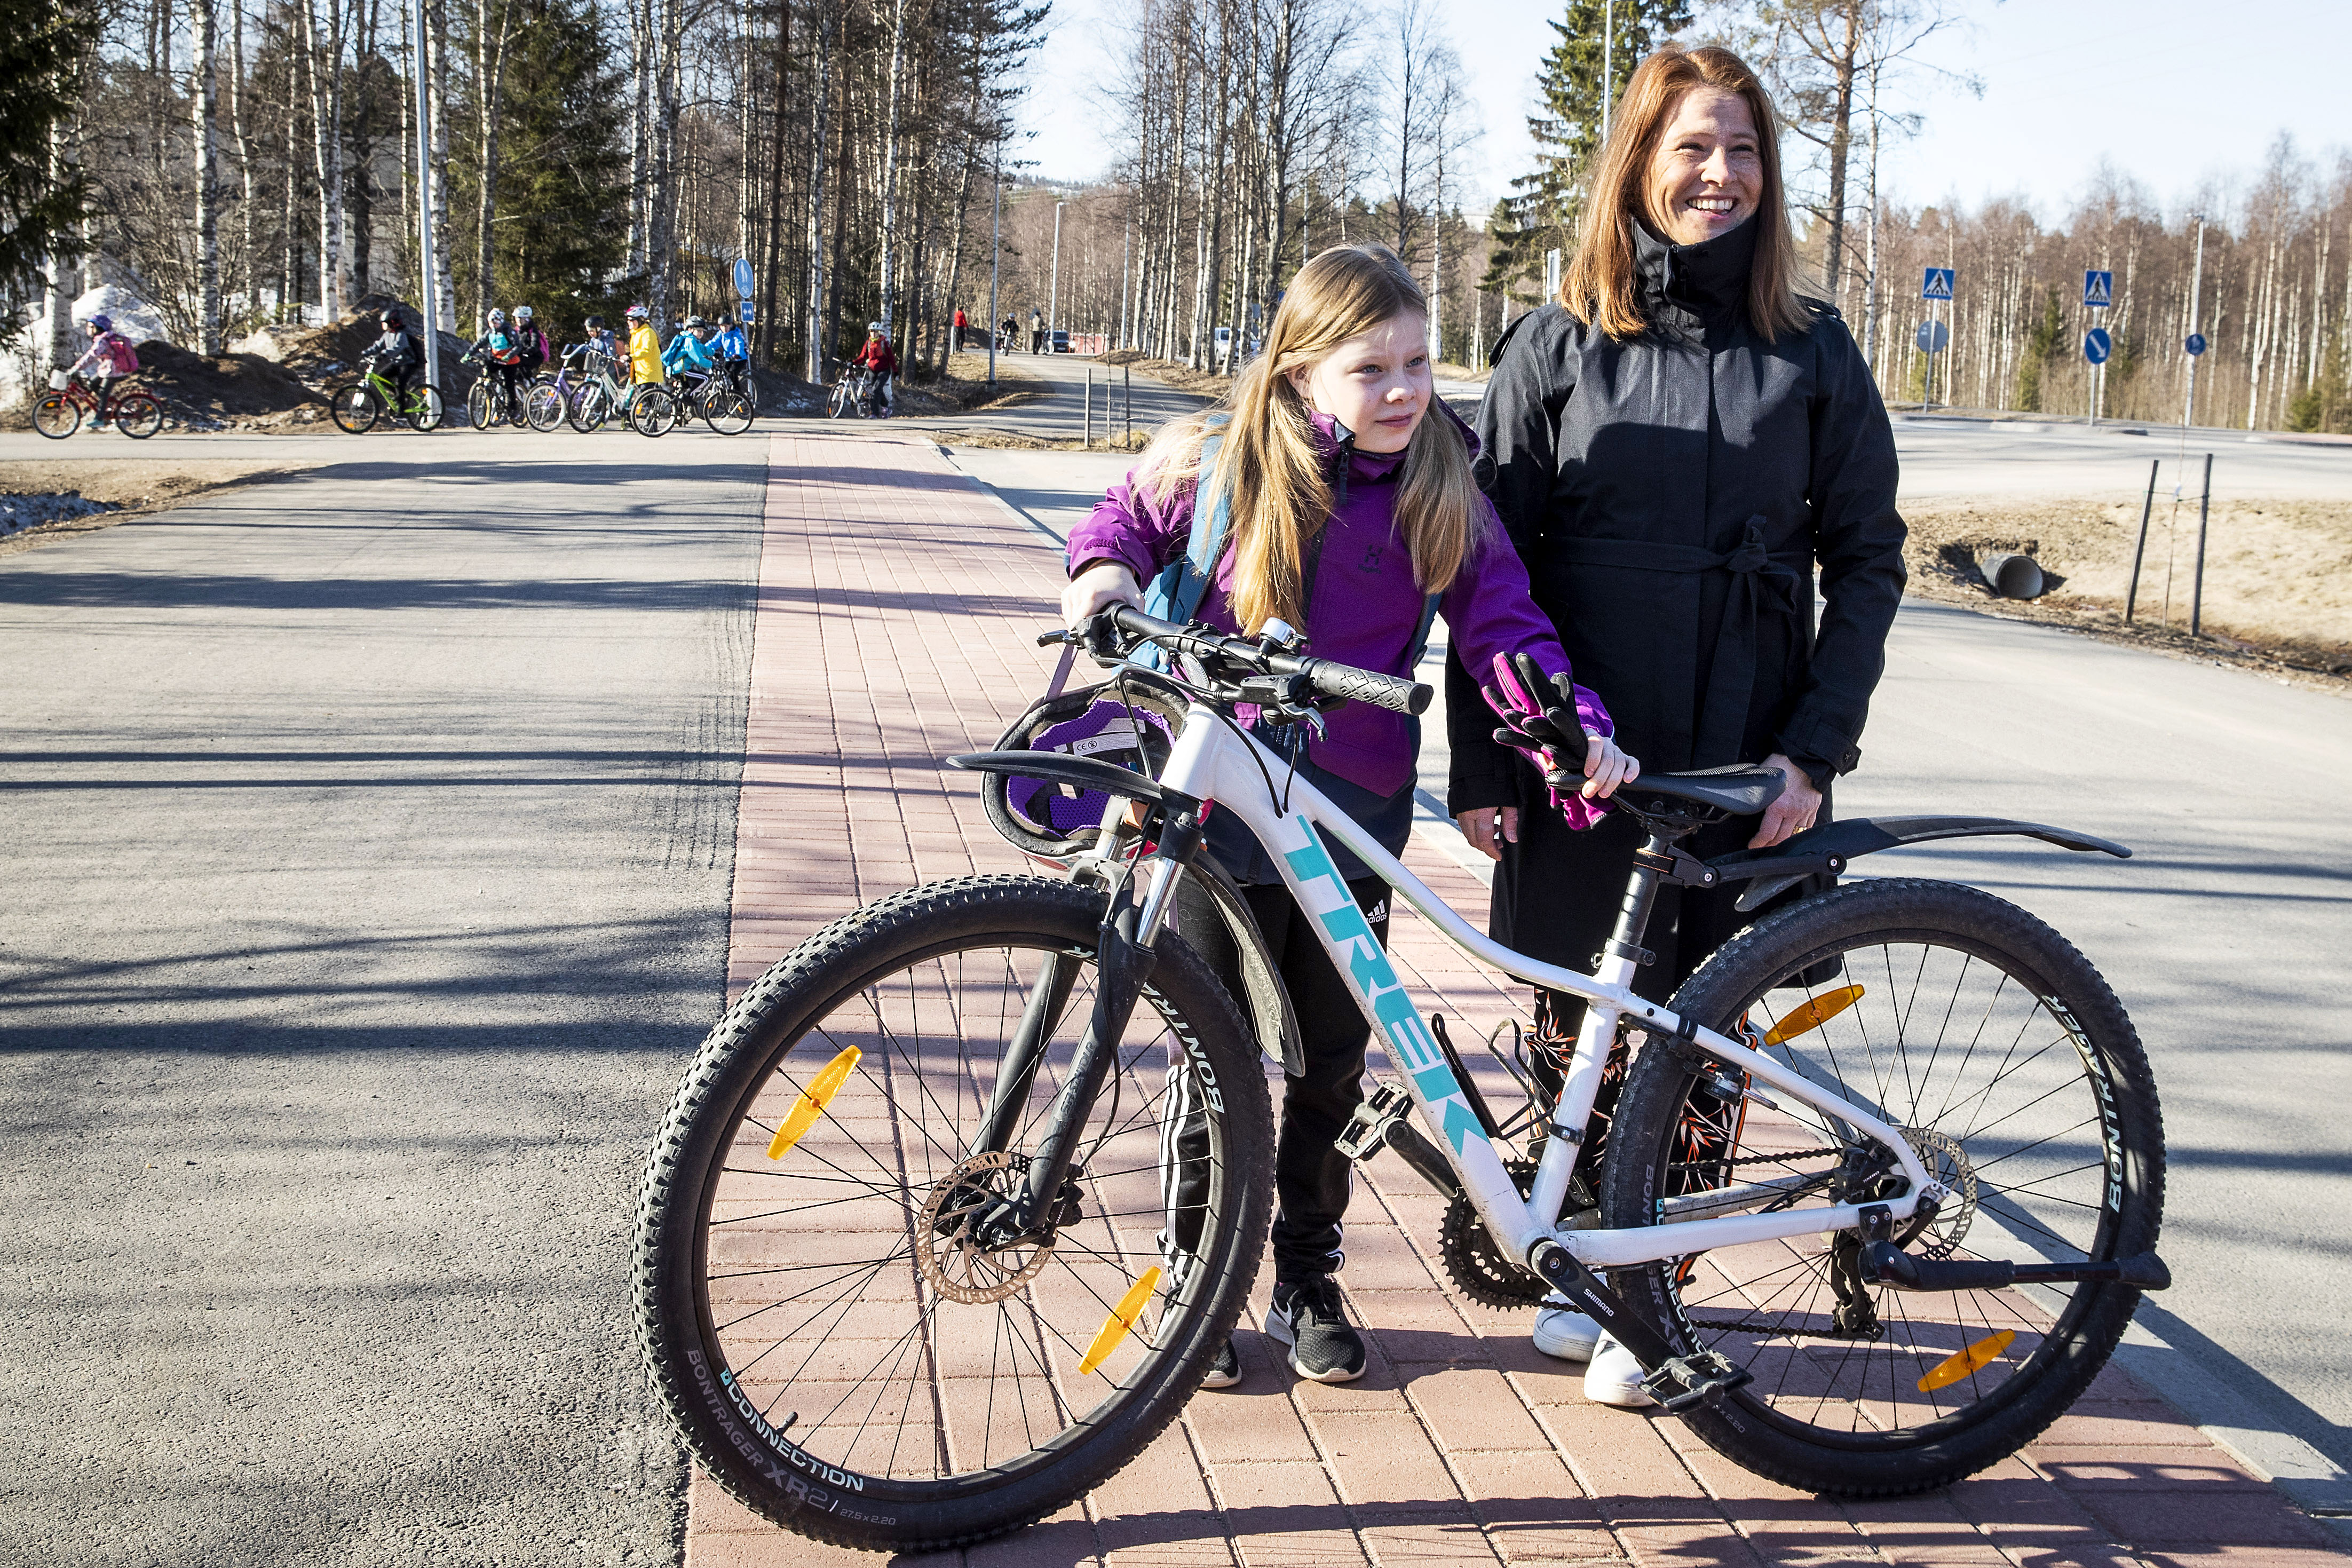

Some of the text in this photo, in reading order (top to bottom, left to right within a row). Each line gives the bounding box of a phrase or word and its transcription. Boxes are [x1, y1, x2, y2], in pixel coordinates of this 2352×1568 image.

[1366, 913, 1387, 923] didas
[1284, 814, 1490, 1158] TREK
[2041, 994, 2124, 1213] BONTRAGER
[1583, 1288, 1614, 1317] SHIMANO
[687, 1349, 764, 1467] BONTRAGER
[727, 1384, 864, 1492] CONNECTION
